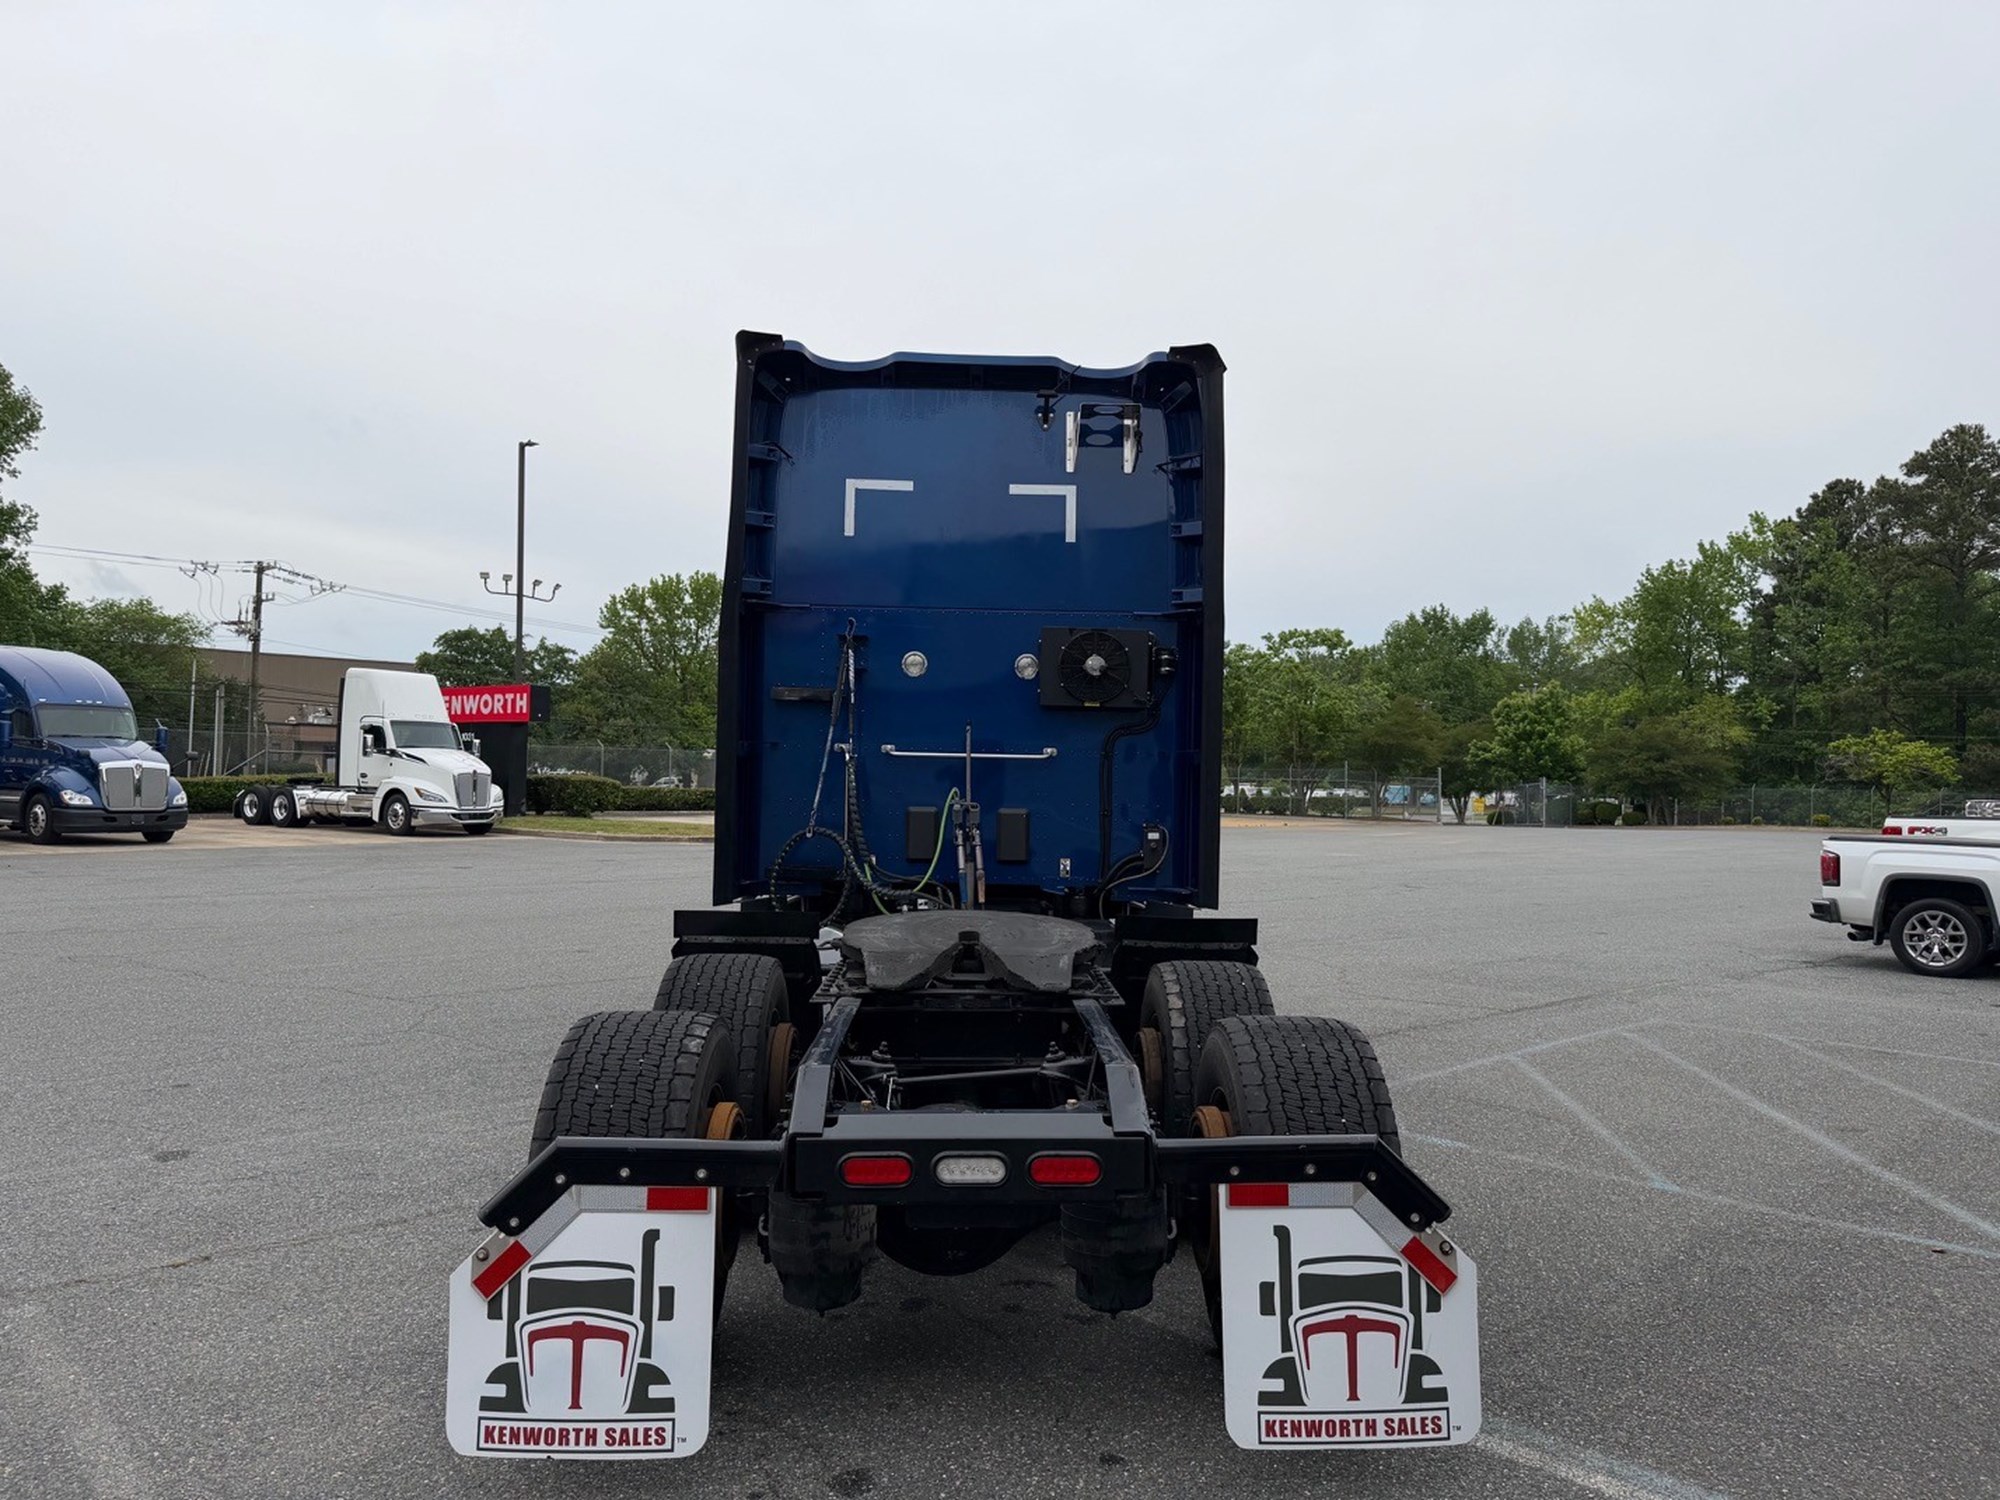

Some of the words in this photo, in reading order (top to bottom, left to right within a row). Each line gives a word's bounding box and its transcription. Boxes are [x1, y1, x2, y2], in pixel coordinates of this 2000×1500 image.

[1907, 826, 1948, 836] FX4
[483, 1425, 598, 1447] KENWORTH
[604, 1426, 667, 1447] SALES
[1264, 1418, 1377, 1438] KENWORTH
[1383, 1415, 1443, 1436] SALES
